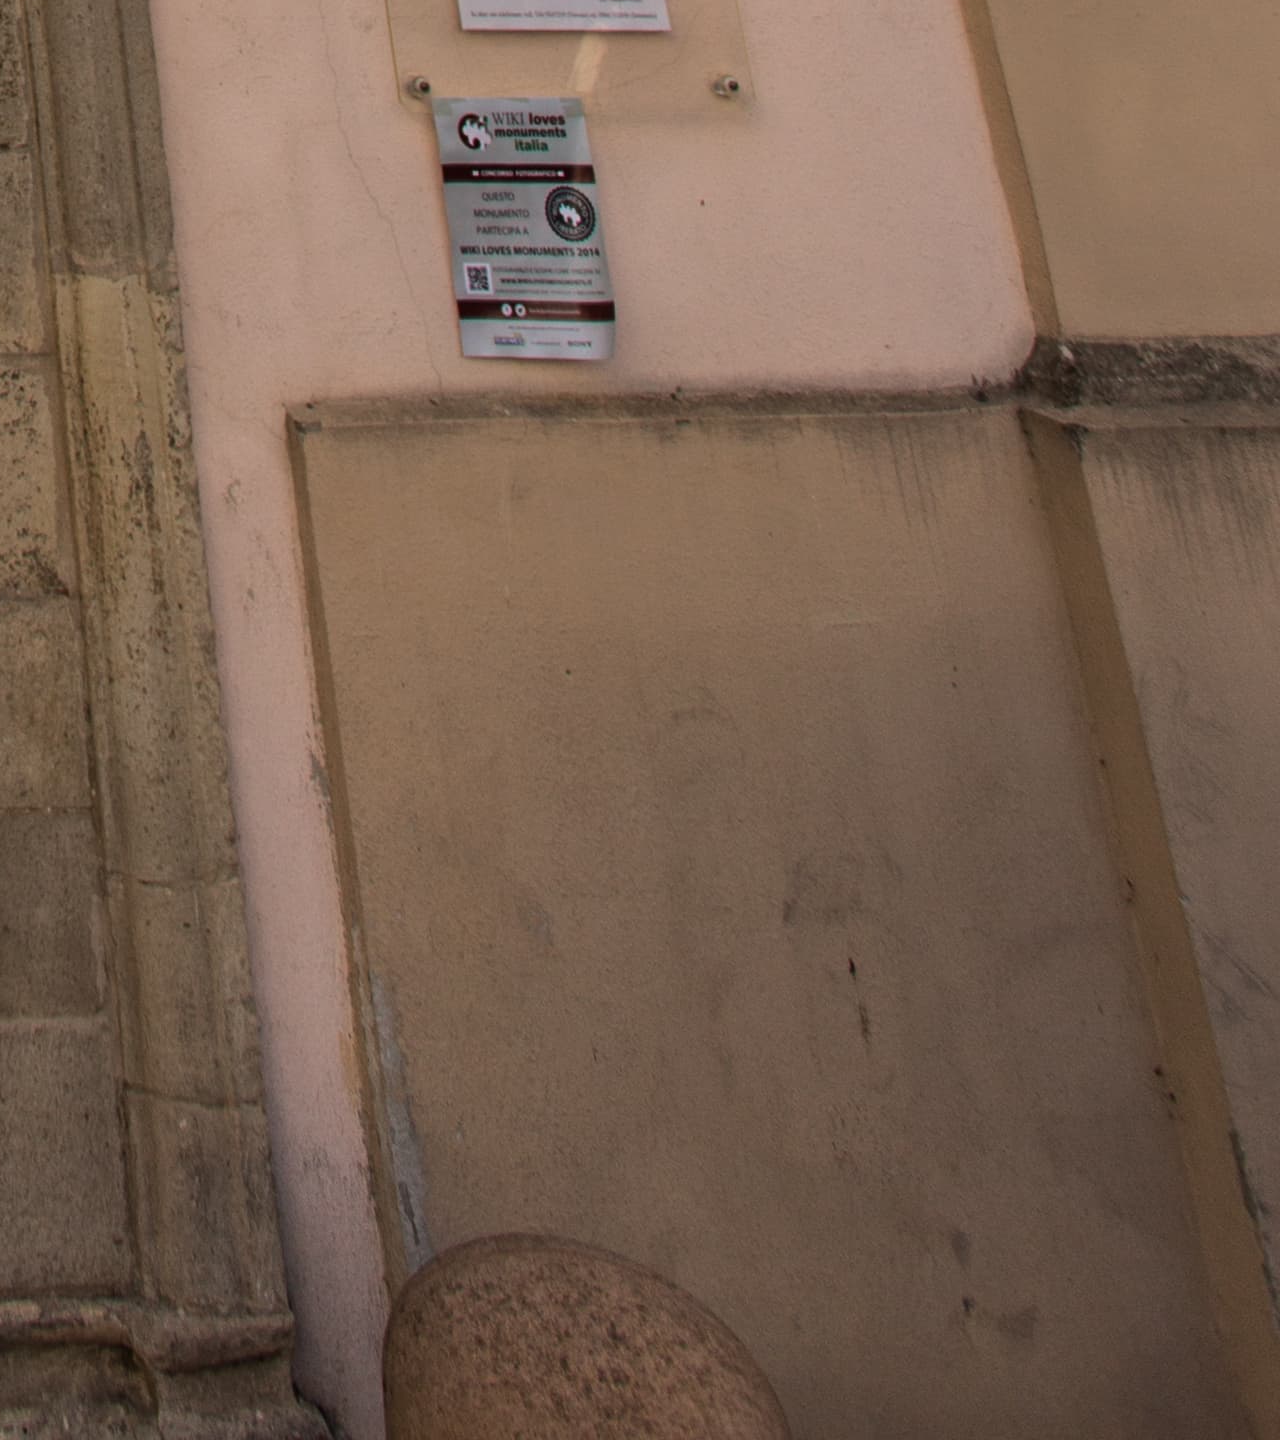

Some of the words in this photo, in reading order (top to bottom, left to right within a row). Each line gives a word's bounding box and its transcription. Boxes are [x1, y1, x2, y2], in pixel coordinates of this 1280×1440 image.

[491, 111, 525, 126] WIKI
[528, 112, 566, 126] loves
[494, 127, 567, 138] monuments
[514, 139, 549, 152] italia
[481, 191, 515, 202] QUESTO
[473, 208, 530, 219] MONUMENTO
[476, 225, 521, 236] PARTECIPA
[521, 225, 529, 236] A
[459, 245, 480, 256] WIKI
[482, 245, 512, 256] LOVES
[513, 246, 575, 257] MONUMENTS
